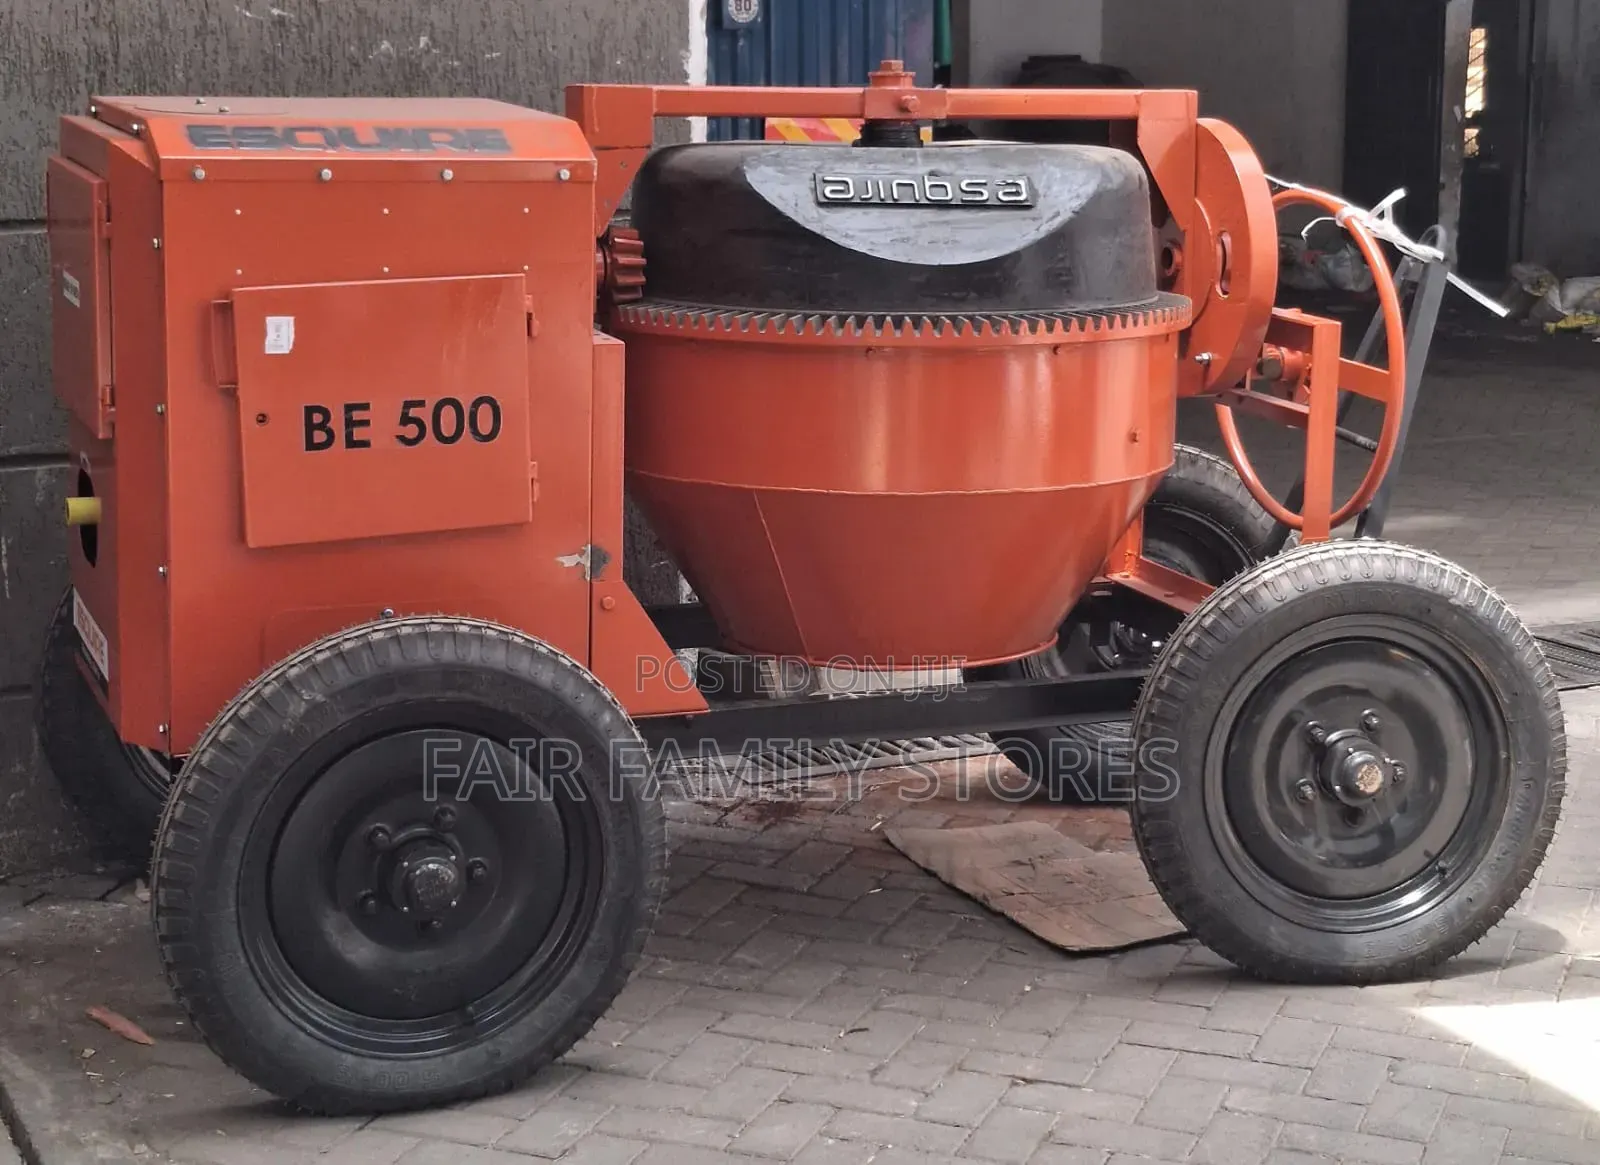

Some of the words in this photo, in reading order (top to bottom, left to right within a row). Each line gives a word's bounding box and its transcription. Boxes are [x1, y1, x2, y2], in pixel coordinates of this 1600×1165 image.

[186, 124, 513, 153] ESQUIRE
[303, 402, 372, 452] BE
[395, 395, 501, 447] 500
